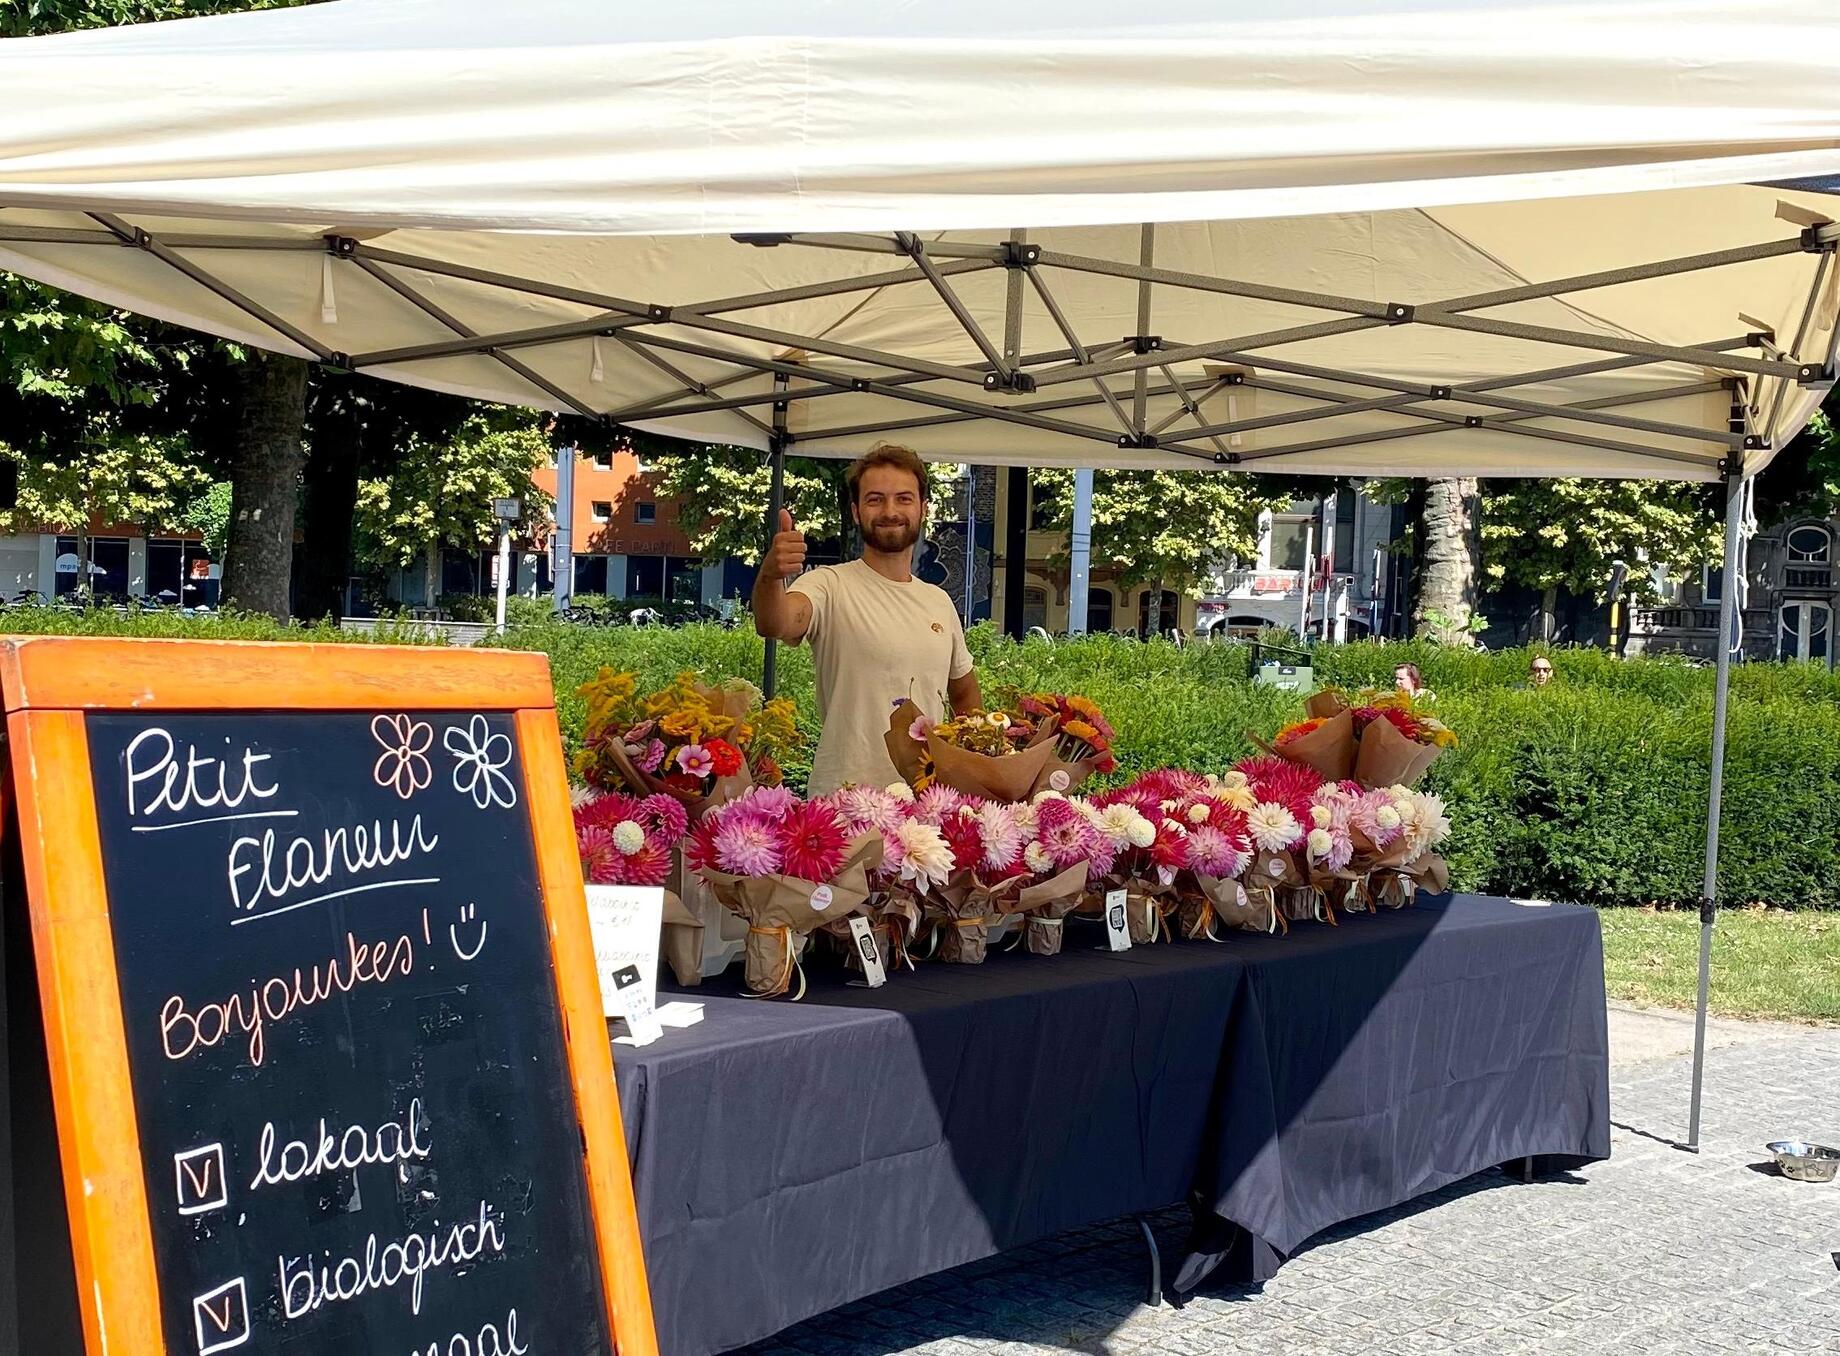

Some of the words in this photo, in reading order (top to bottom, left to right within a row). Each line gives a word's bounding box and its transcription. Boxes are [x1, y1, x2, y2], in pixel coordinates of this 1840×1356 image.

[126, 727, 279, 815] Petit
[227, 813, 439, 911] Flaneur
[249, 1097, 434, 1192] lokaal
[279, 1199, 506, 1317] biologisch
